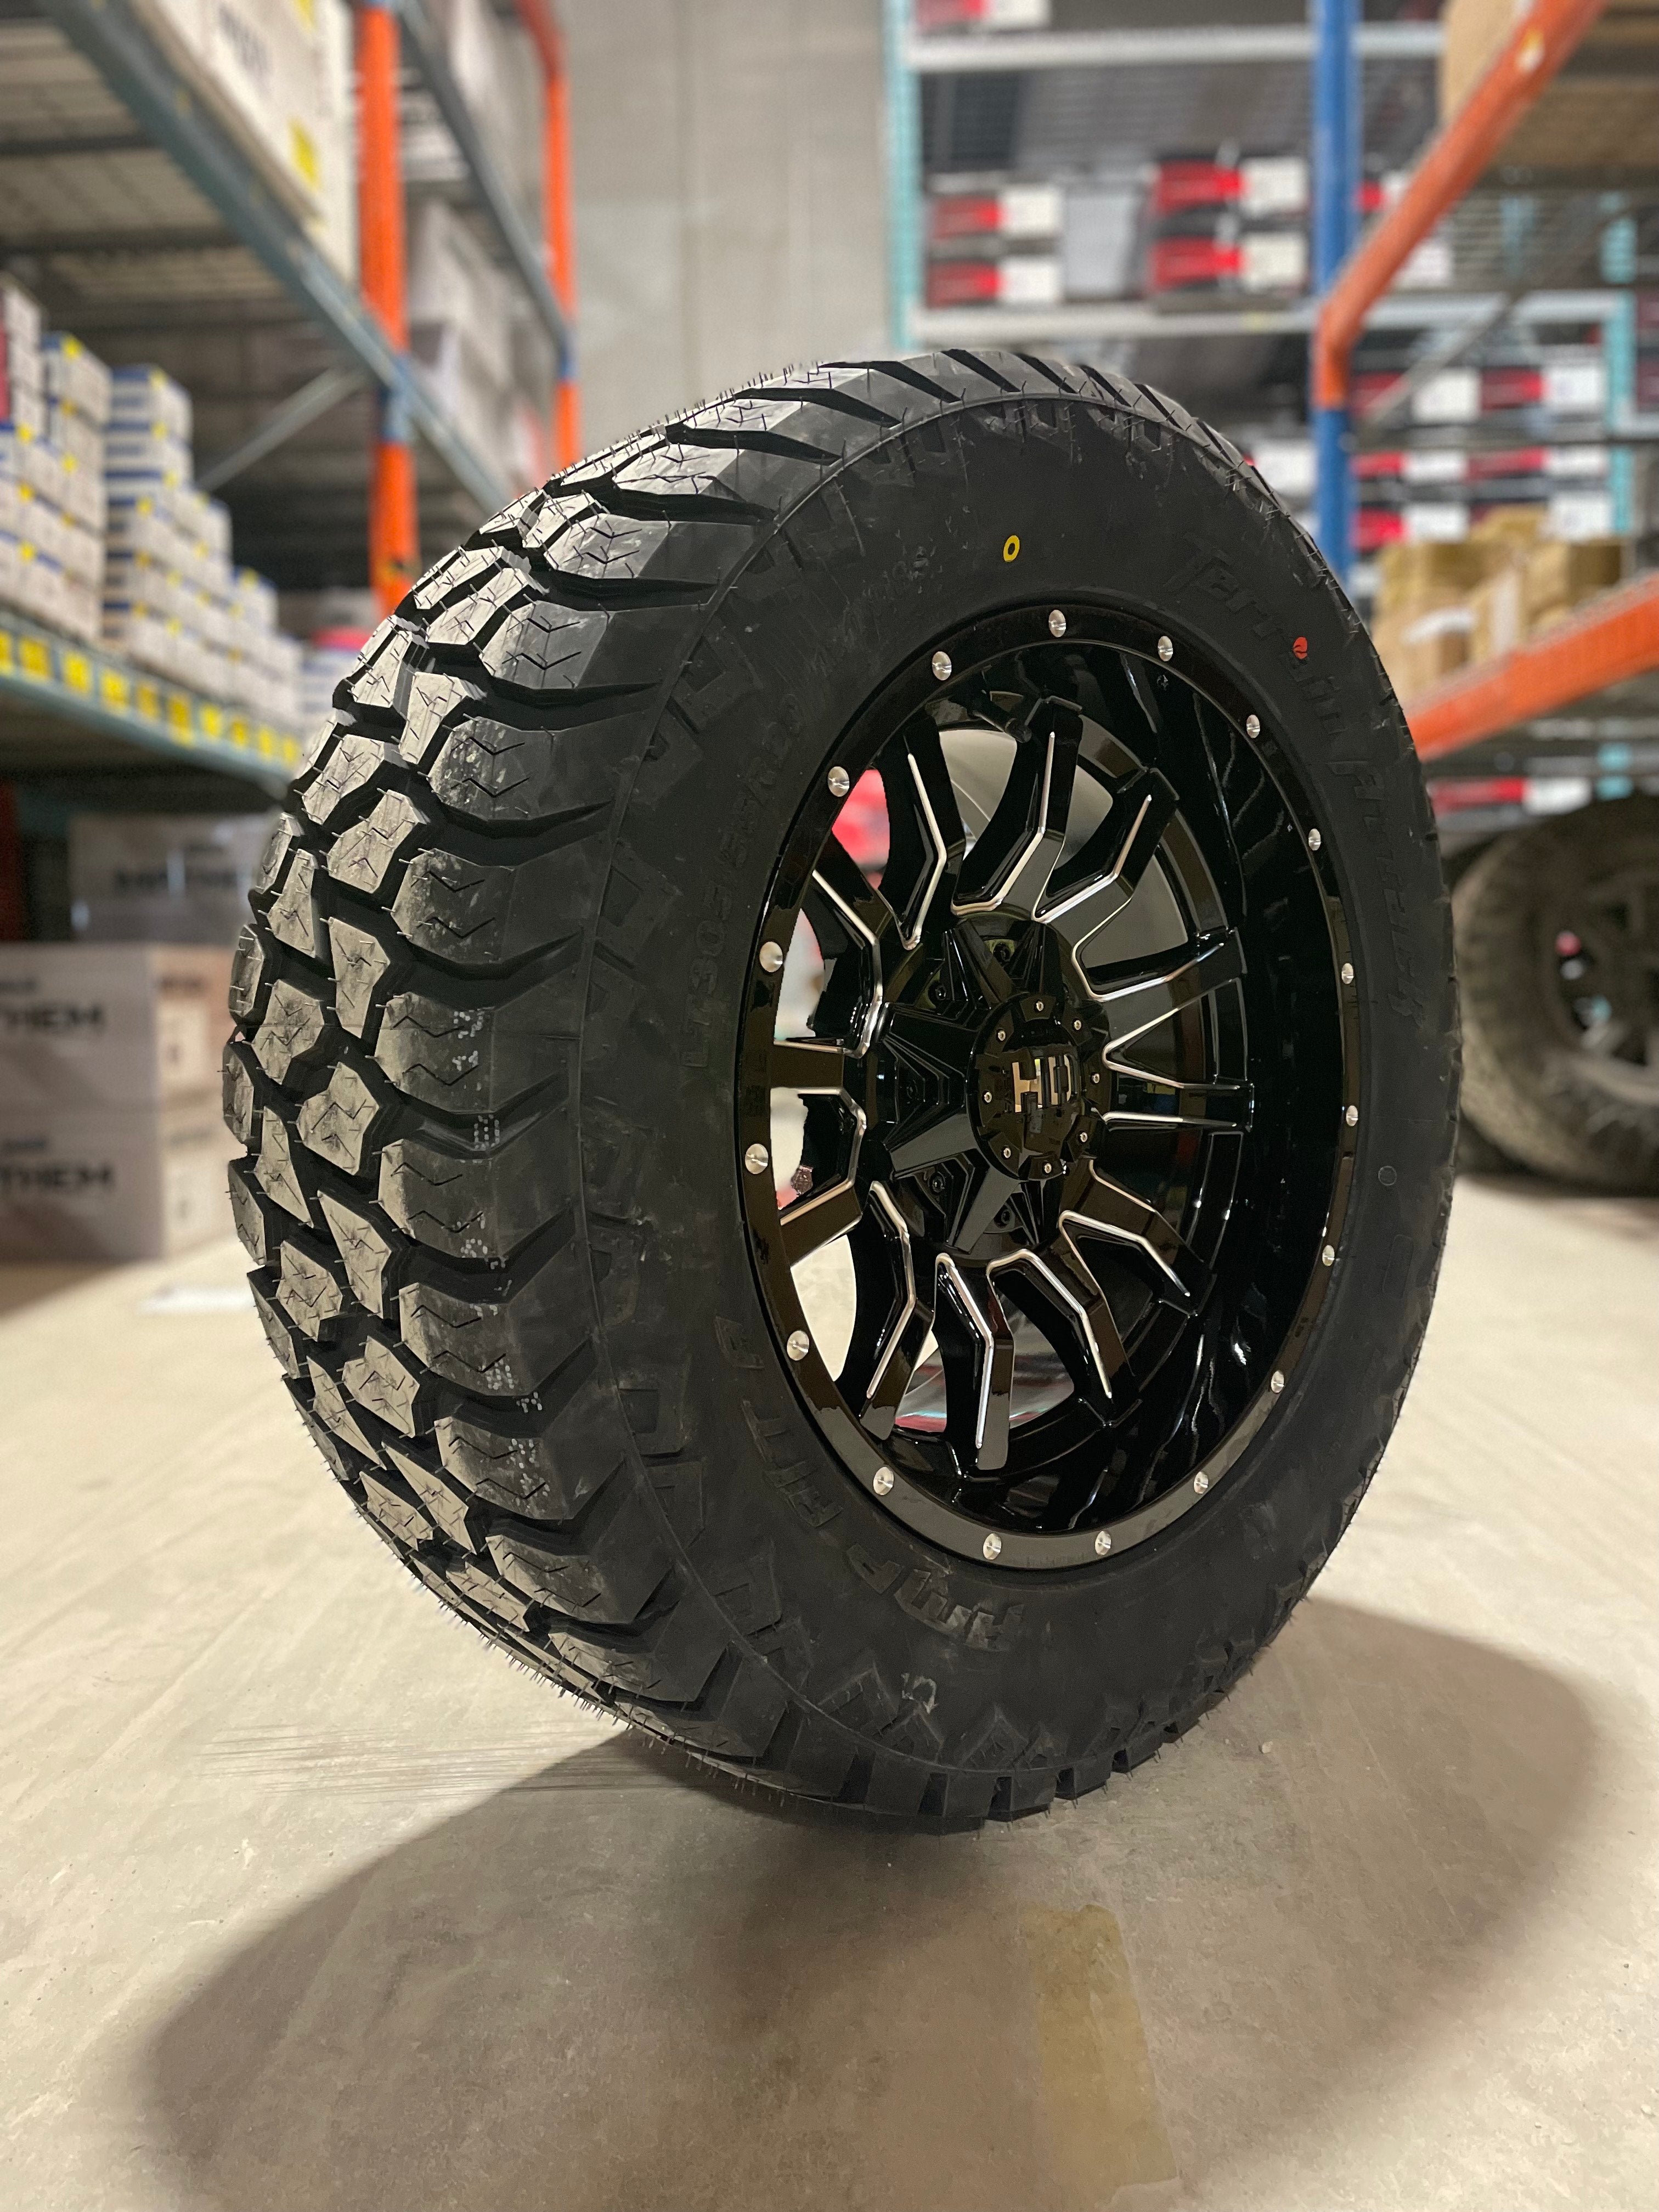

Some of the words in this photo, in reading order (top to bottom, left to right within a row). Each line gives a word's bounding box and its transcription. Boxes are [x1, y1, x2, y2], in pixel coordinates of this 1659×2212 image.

[1163, 532, 1348, 747] Terrain
[1328, 759, 1424, 1026] Attack
[1011, 1054, 1072, 1114] HD
[742, 1400, 843, 1530] A/T
[848, 1543, 1024, 1651] AMP
